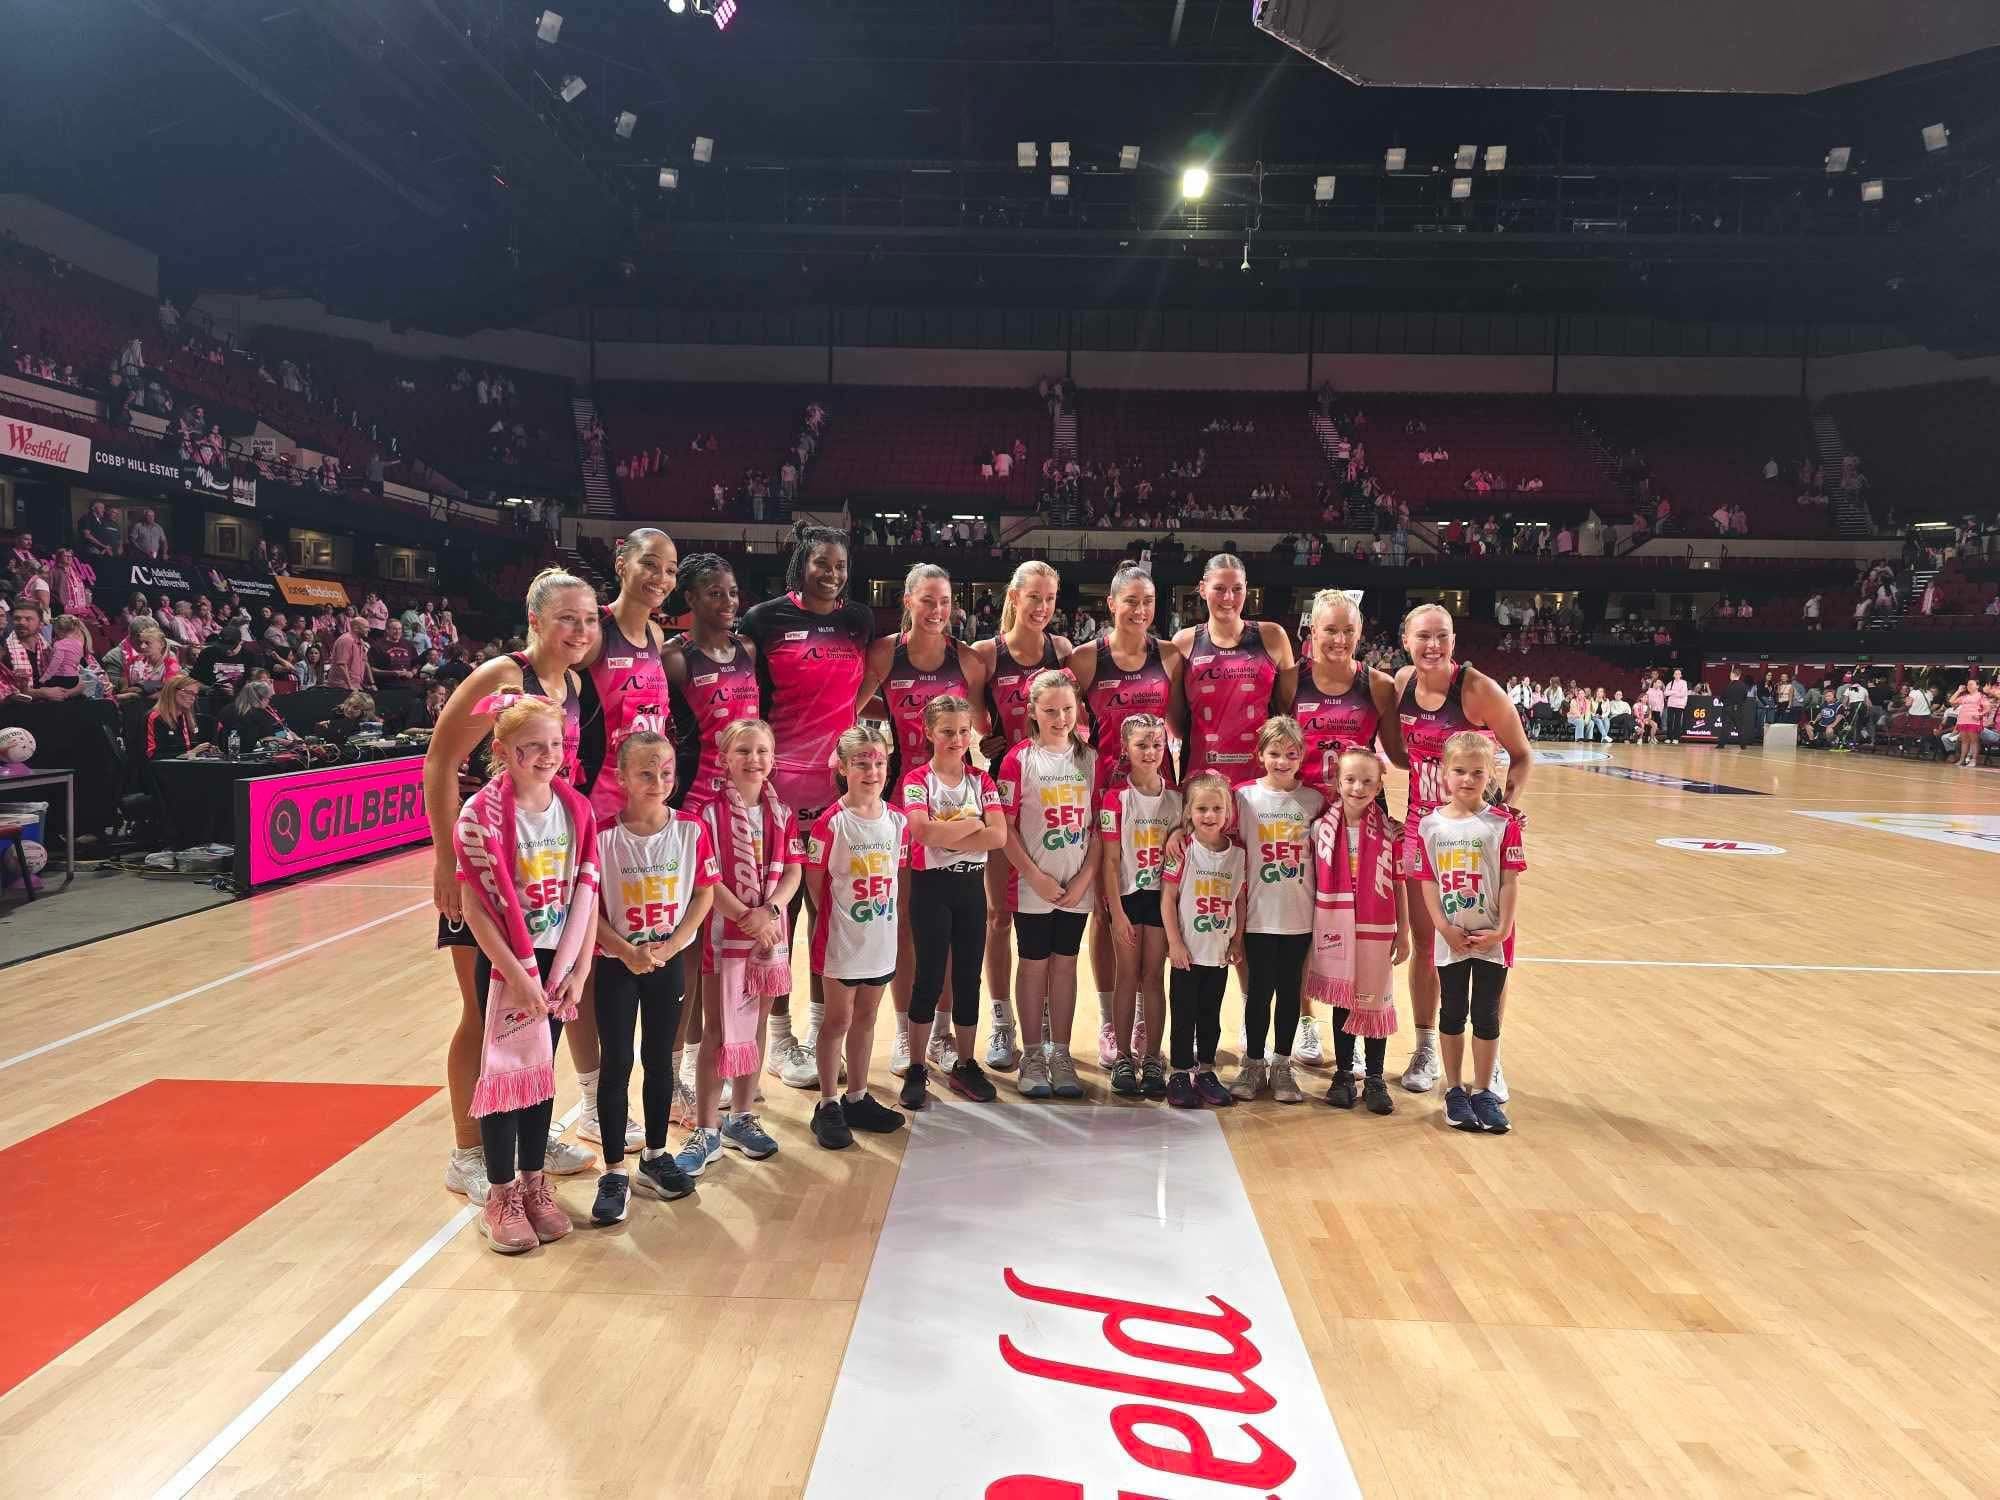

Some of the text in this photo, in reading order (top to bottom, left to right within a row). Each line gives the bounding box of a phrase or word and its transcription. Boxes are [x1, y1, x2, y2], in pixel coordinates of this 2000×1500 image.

[8, 423, 69, 465] Westfield
[128, 459, 147, 473] HILL
[149, 463, 180, 479] ESTATE
[1041, 784, 1088, 806] NET
[309, 782, 426, 842] GILBERT
[1044, 805, 1085, 829] SET
[1258, 820, 1305, 843] NET
[518, 850, 569, 880] NET
[850, 851, 891, 878] NET
[1261, 842, 1302, 864] SET
[1437, 849, 1482, 873] NET
[526, 879, 569, 909] SET
[622, 875, 680, 906] NET
[852, 876, 893, 900] SET
[1194, 879, 1232, 898] NET
[1441, 870, 1483, 894] SET
[626, 903, 679, 932] SET
[1196, 896, 1233, 917] SET
